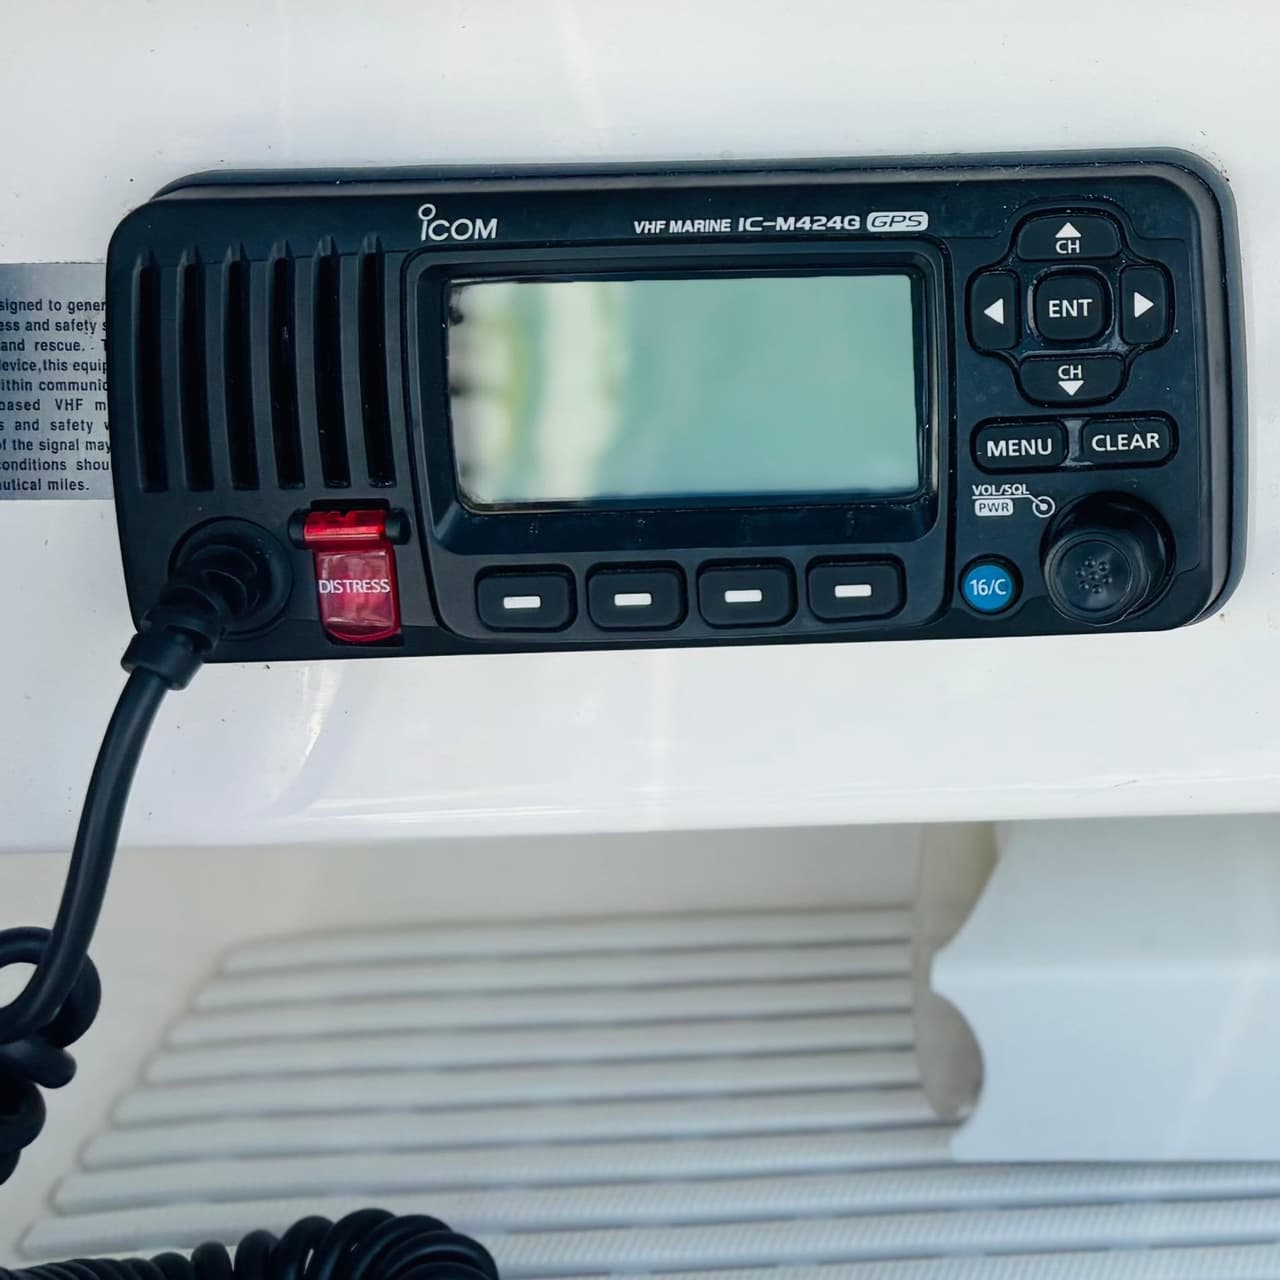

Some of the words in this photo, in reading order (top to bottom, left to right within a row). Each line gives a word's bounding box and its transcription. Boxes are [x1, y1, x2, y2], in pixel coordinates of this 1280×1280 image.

[633, 220, 666, 234] VHF
[669, 218, 731, 233] MARINE
[738, 215, 861, 231] IC-M424G
[870, 213, 926, 230] GPS
[1055, 239, 1081, 254] CH
[48, 299, 62, 311] to
[1049, 298, 1093, 318] ENT
[25, 319, 50, 331] and
[55, 319, 97, 335] safety
[1, 339, 25, 351] and
[34, 340, 85, 352] rescue.
[1057, 365, 1083, 379] CH
[55, 398, 84, 411] VHF
[15, 419, 39, 431] and
[50, 418, 93, 434] safety
[12, 438, 33, 451] the
[39, 438, 79, 454] signal
[85, 440, 111, 454] may
[986, 438, 1053, 457] MENU
[1091, 433, 1161, 452] CLEAR
[0, 458, 67, 471] onditions
[0, 478, 41, 491] utical
[48, 478, 90, 491] miles.
[972, 483, 1030, 495] VOL/SQL
[978, 502, 1011, 513] PWR
[318, 579, 391, 594] DISTRESS
[968, 578, 1007, 596] 16/C
